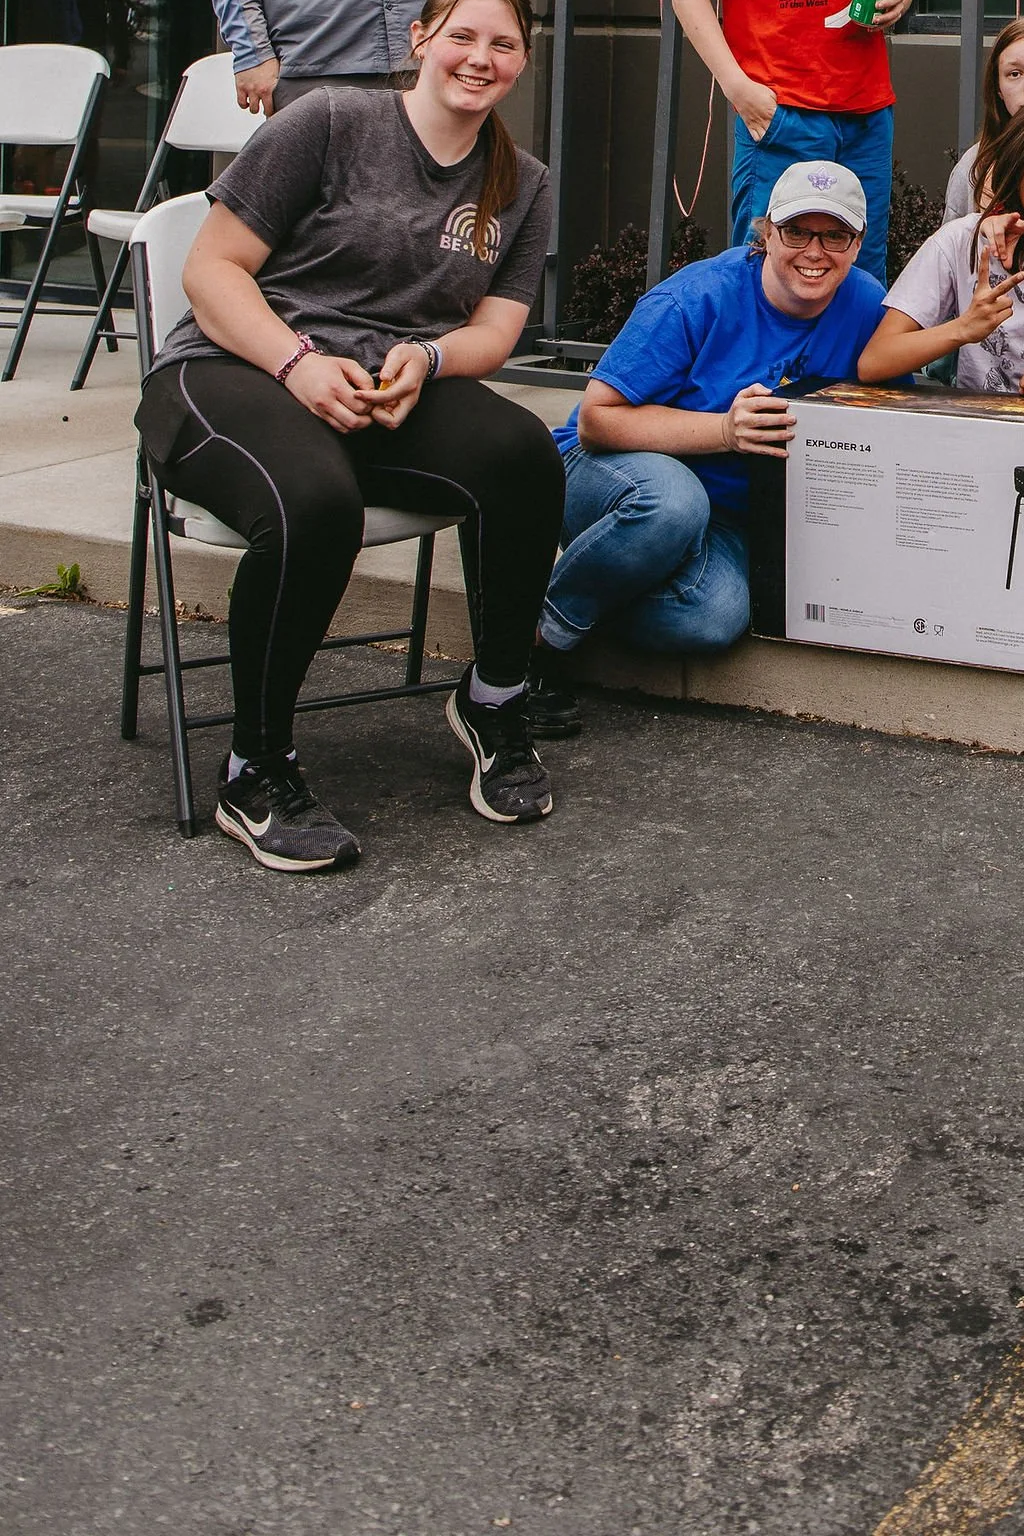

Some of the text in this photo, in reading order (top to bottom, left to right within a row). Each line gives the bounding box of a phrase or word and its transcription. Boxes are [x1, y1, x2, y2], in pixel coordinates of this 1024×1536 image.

[806, 0, 829, 8] West
[440, 234, 462, 252] BE
[805, 438, 872, 453] EXPLORER 14
